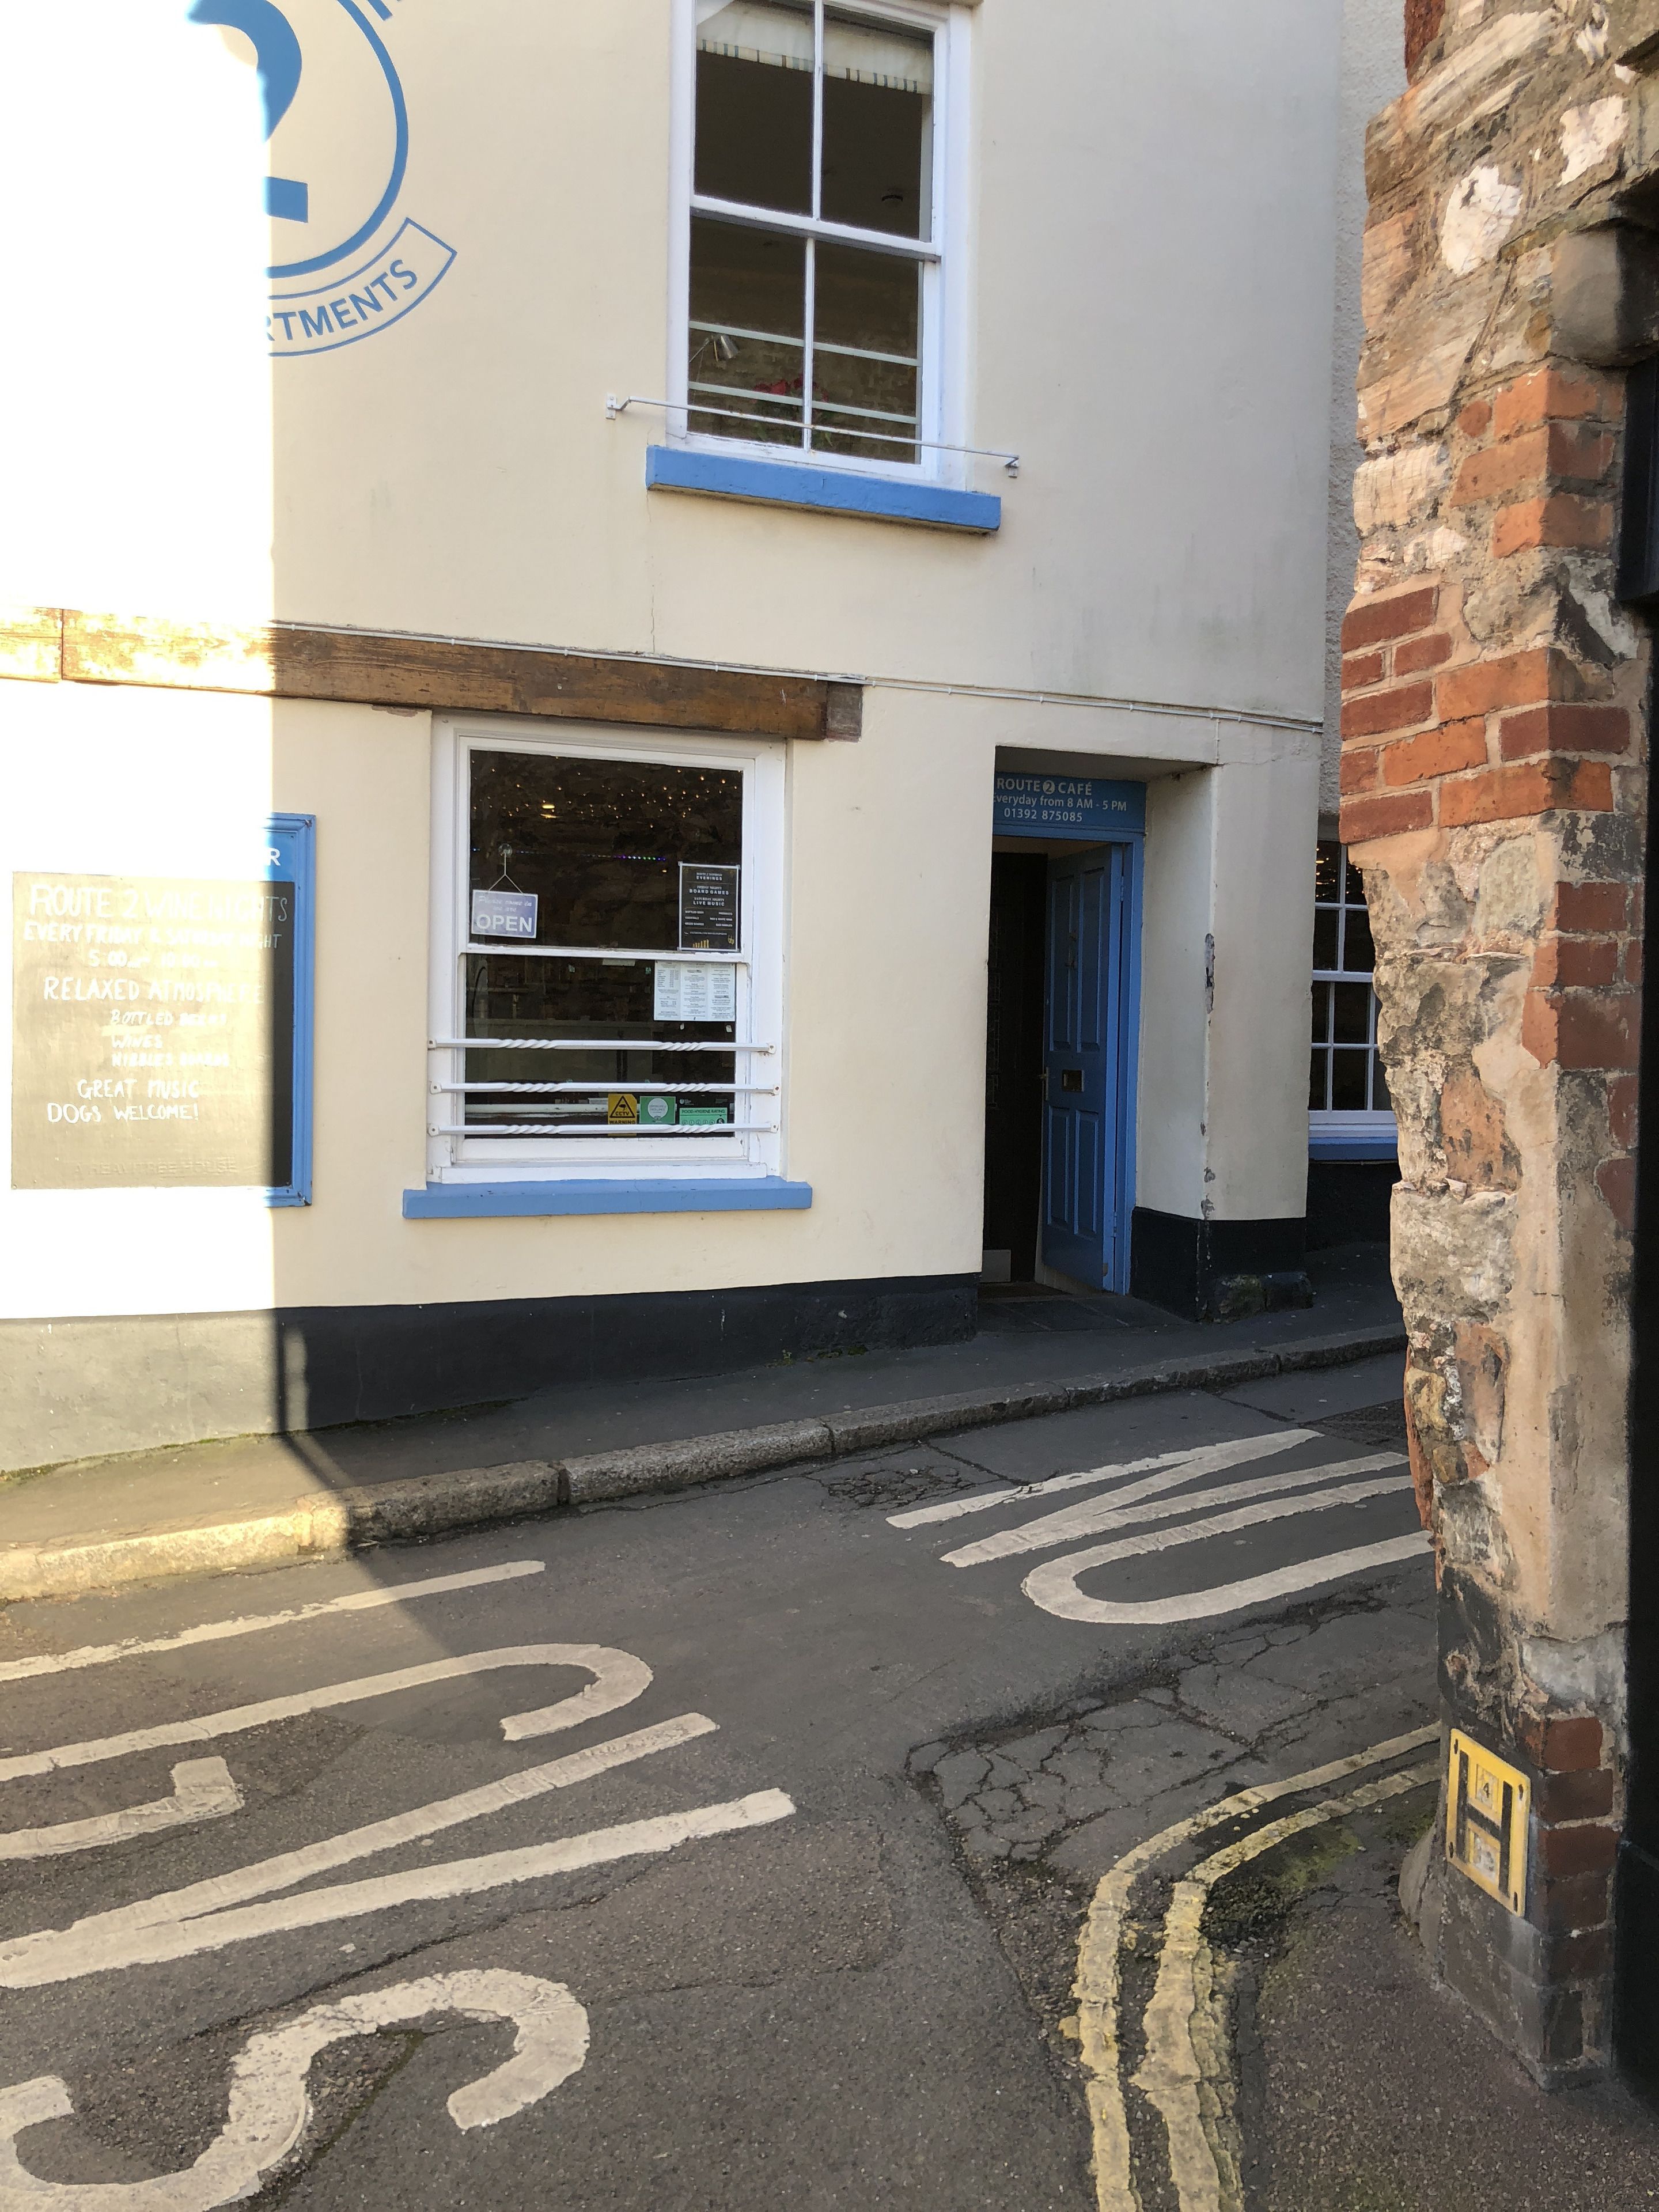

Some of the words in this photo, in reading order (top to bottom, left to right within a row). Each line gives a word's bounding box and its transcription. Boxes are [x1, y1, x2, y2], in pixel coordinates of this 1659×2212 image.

[996, 778, 1040, 792] ROUTE
[1044, 781, 1054, 794] 2
[1058, 782, 1092, 796] CAFÉ
[1040, 796, 1064, 807] from
[1067, 798, 1073, 808] 8
[1076, 798, 1093, 809] AM
[1102, 800, 1108, 810] 5
[1111, 801, 1127, 811] PM
[1004, 808, 1037, 820] 01392
[1041, 811, 1083, 823] 875085
[29, 884, 112, 918] ROUTE
[120, 889, 138, 919] 2
[24, 921, 83, 943] EVERY
[476, 914, 532, 933] OPEN
[43, 977, 140, 1001] RELAXED
[111, 1009, 173, 1026] BOTTLED
[112, 1035, 164, 1049] WINES
[77, 1078, 137, 1099] GREAT
[147, 1078, 200, 1099] MUSIC
[47, 1103, 102, 1124] DOGS
[113, 1103, 199, 1121] WELCOME!
[1456, 1749, 1513, 1899] H
